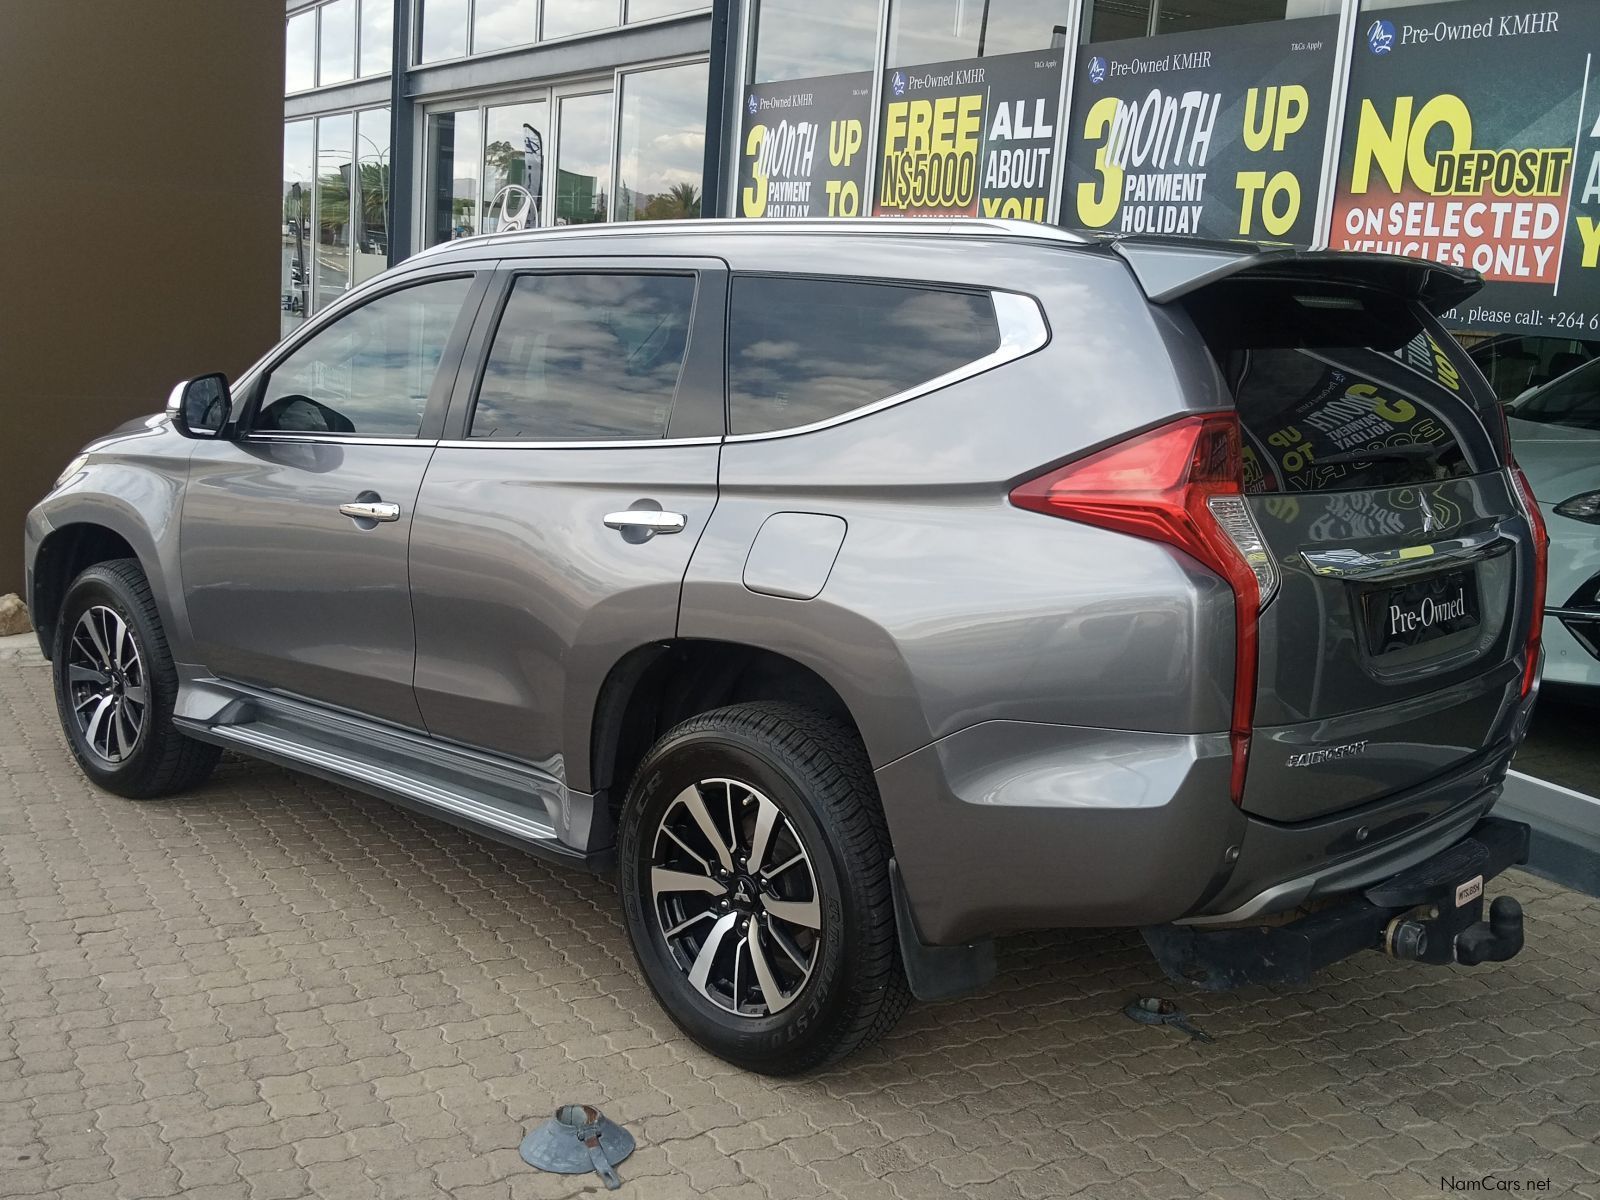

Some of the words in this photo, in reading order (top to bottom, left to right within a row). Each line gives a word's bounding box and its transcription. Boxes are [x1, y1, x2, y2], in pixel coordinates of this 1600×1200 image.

[1400, 18, 1493, 45] Pre-Owned
[1497, 11, 1560, 37] KMHR
[908, 73, 954, 90] Pre-Owned
[955, 68, 985, 85] KMHR
[1109, 56, 1170, 77] Pre-Owned
[1172, 51, 1212, 71] KMHR
[760, 96, 792, 110] Pre-Owned
[792, 93, 814, 107] KMHR
[988, 99, 1053, 141] ALL
[1242, 84, 1309, 152] UP
[829, 120, 863, 167] UP
[885, 95, 983, 154] FREE
[1350, 94, 1473, 194] NO
[743, 124, 768, 217] 3
[880, 150, 977, 208] N$5000
[984, 147, 1051, 189] ABOUT
[1076, 97, 1125, 228] 3
[1430, 148, 1573, 197] DEPOSIT
[768, 182, 812, 202] PAYMENT
[825, 180, 859, 217] TO
[1124, 173, 1207, 202] PAYMENT
[1235, 170, 1301, 236] TO
[767, 205, 810, 217] HOLIDAY
[1120, 205, 1203, 234] HOLIDAY
[1345, 207, 1385, 236] ON
[1387, 201, 1560, 240] SELECTED
[1472, 243, 1555, 277] ONLY
[1468, 306, 1512, 324] please
[1514, 309, 1544, 325] call:
[1547, 311, 1585, 329] +264
[1389, 587, 1465, 635] Pre-Owned
